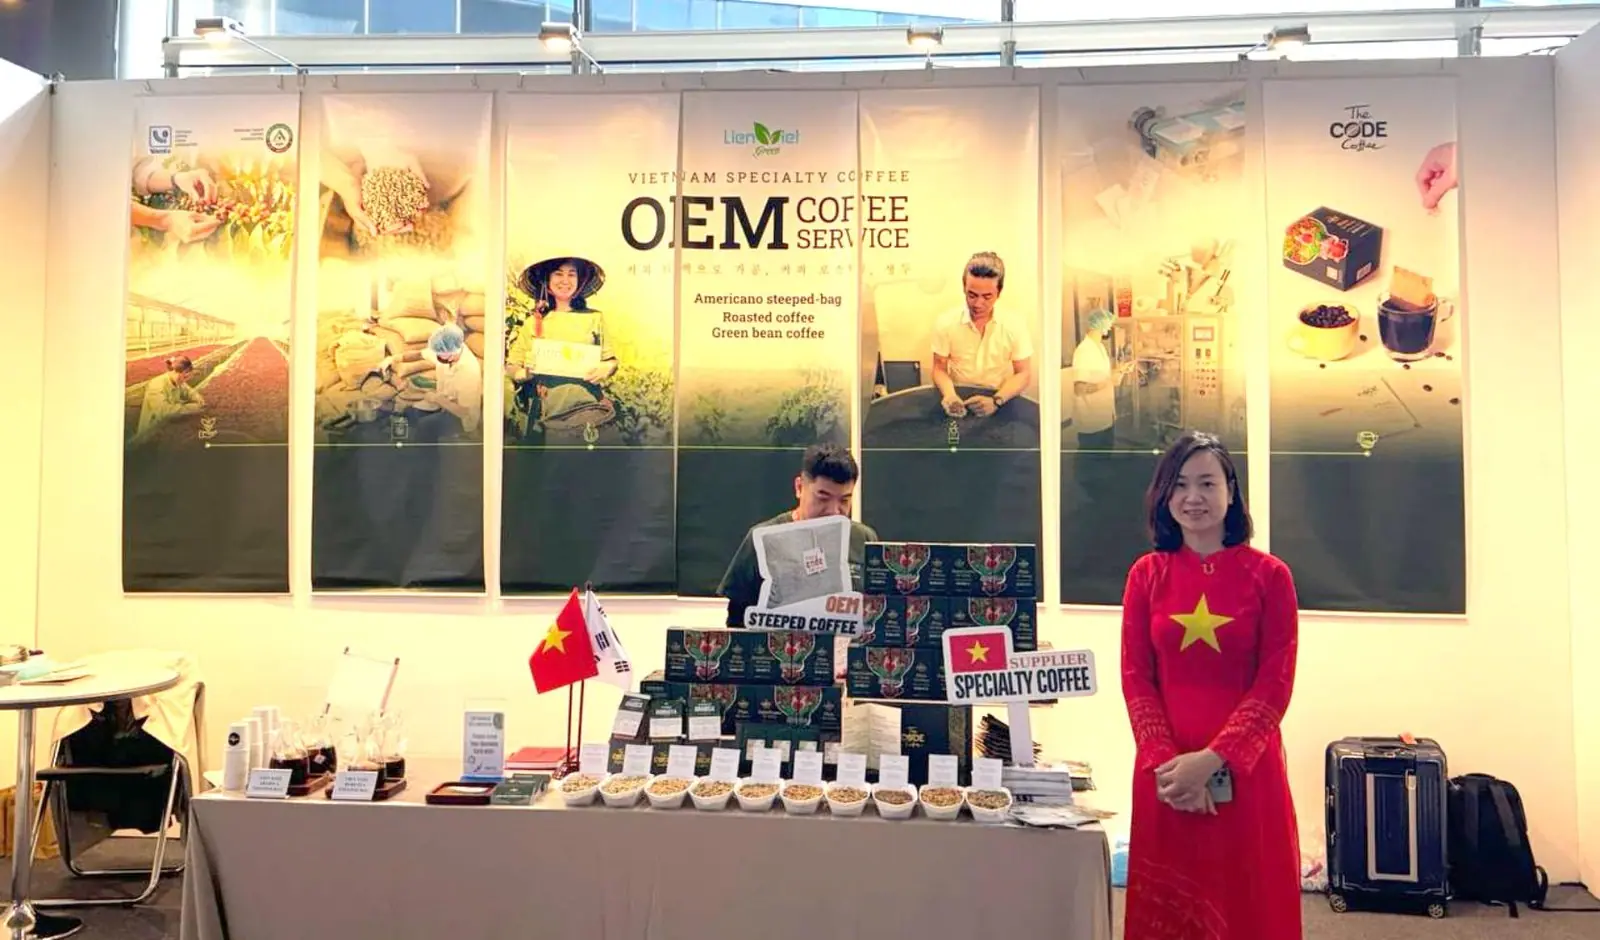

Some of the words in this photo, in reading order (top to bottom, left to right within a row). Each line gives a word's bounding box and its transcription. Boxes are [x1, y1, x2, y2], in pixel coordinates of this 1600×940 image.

[1344, 104, 1372, 119] The
[1330, 121, 1388, 138] CODE
[628, 171, 717, 184] VIETNAM
[726, 171, 828, 184] SPECIALTY
[836, 170, 910, 183] COFFEE
[797, 195, 909, 223] COFEE
[621, 196, 790, 250] OEM
[694, 292, 764, 305] Americano
[766, 293, 843, 307] steeped-bag
[722, 311, 773, 323] Roasted
[775, 311, 816, 323] coffee
[711, 326, 749, 339] Green
[752, 327, 783, 338] bean
[786, 327, 825, 339] coffee
[825, 595, 860, 614] OEM
[748, 612, 806, 630] STEEPED
[808, 617, 858, 635] COFFEE
[1009, 652, 1088, 669] SUPPLIER
[954, 670, 1033, 699] SPECIALTY
[1036, 666, 1091, 693] COFFEE
